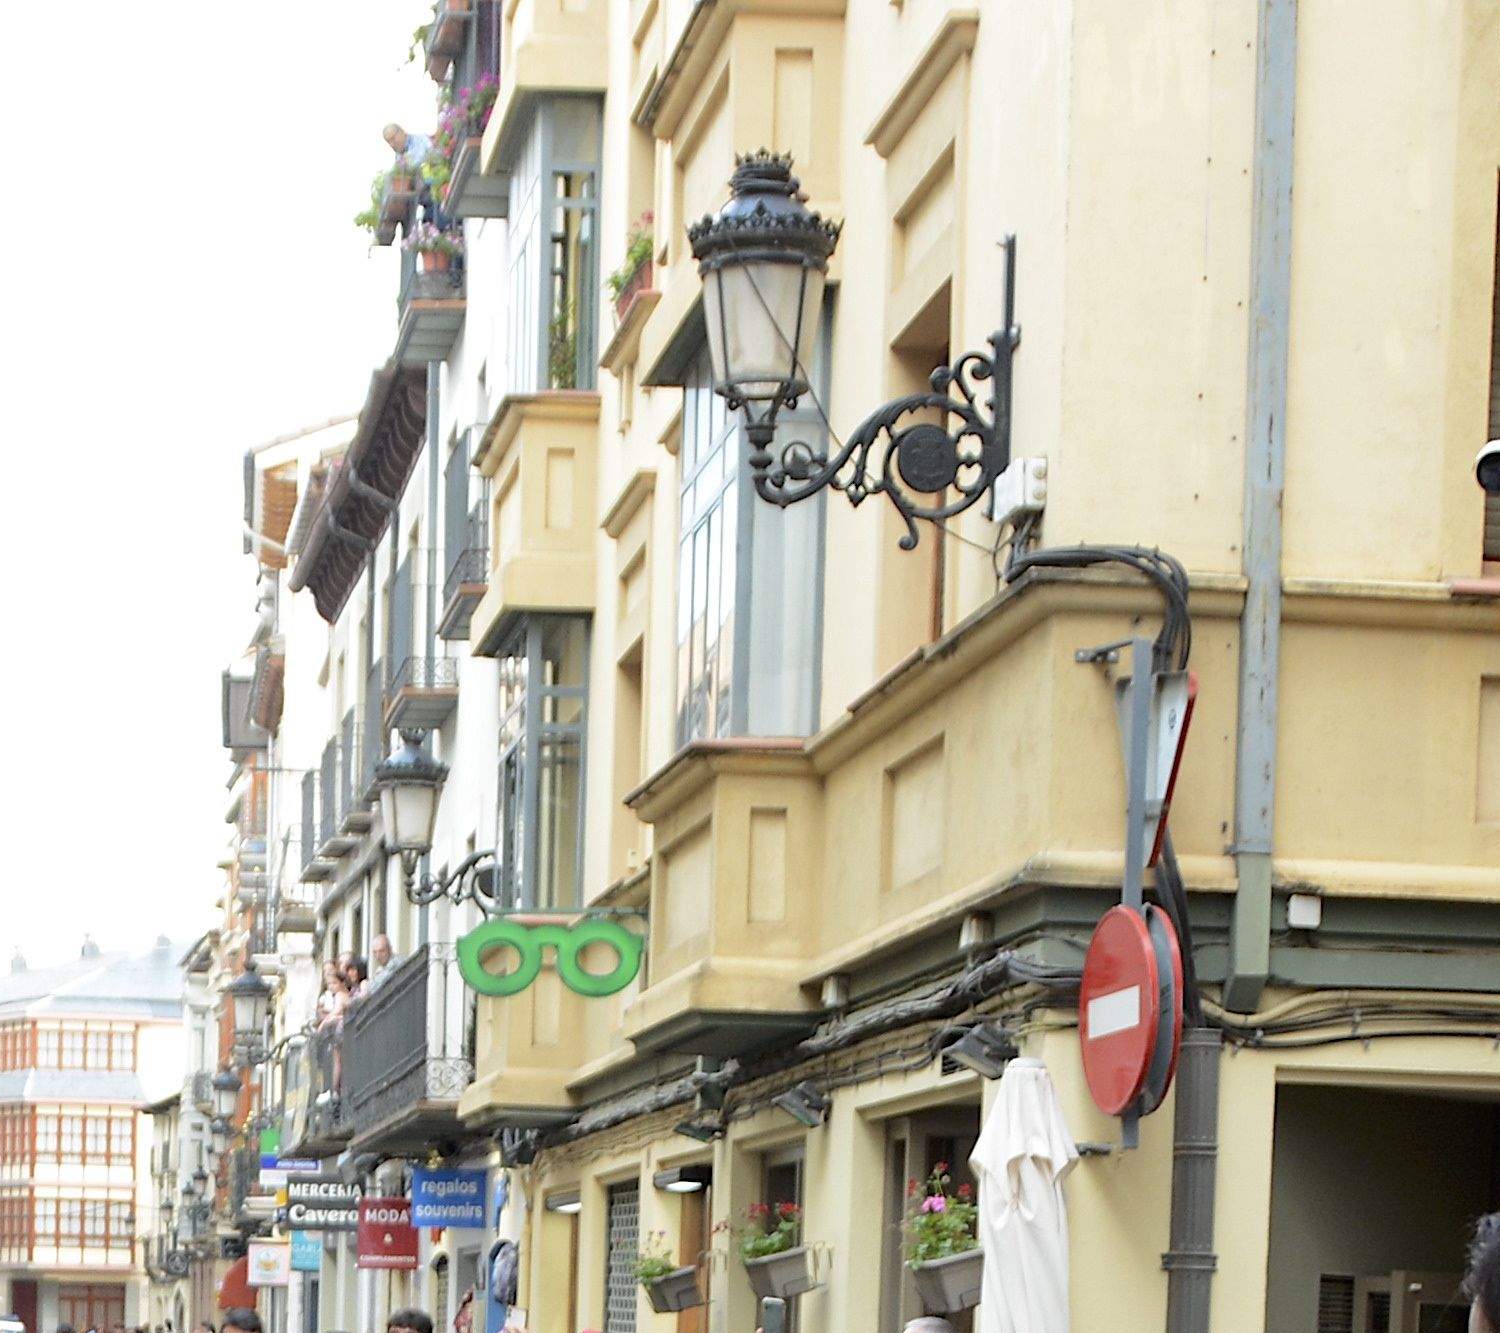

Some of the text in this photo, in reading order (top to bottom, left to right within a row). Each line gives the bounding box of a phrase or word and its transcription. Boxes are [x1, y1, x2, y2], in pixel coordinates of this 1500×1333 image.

[421, 1178, 477, 1195] regalos
[289, 1203, 359, 1222] Cavero
[365, 1208, 409, 1223] MODA
[415, 1203, 483, 1218] souvenirs
